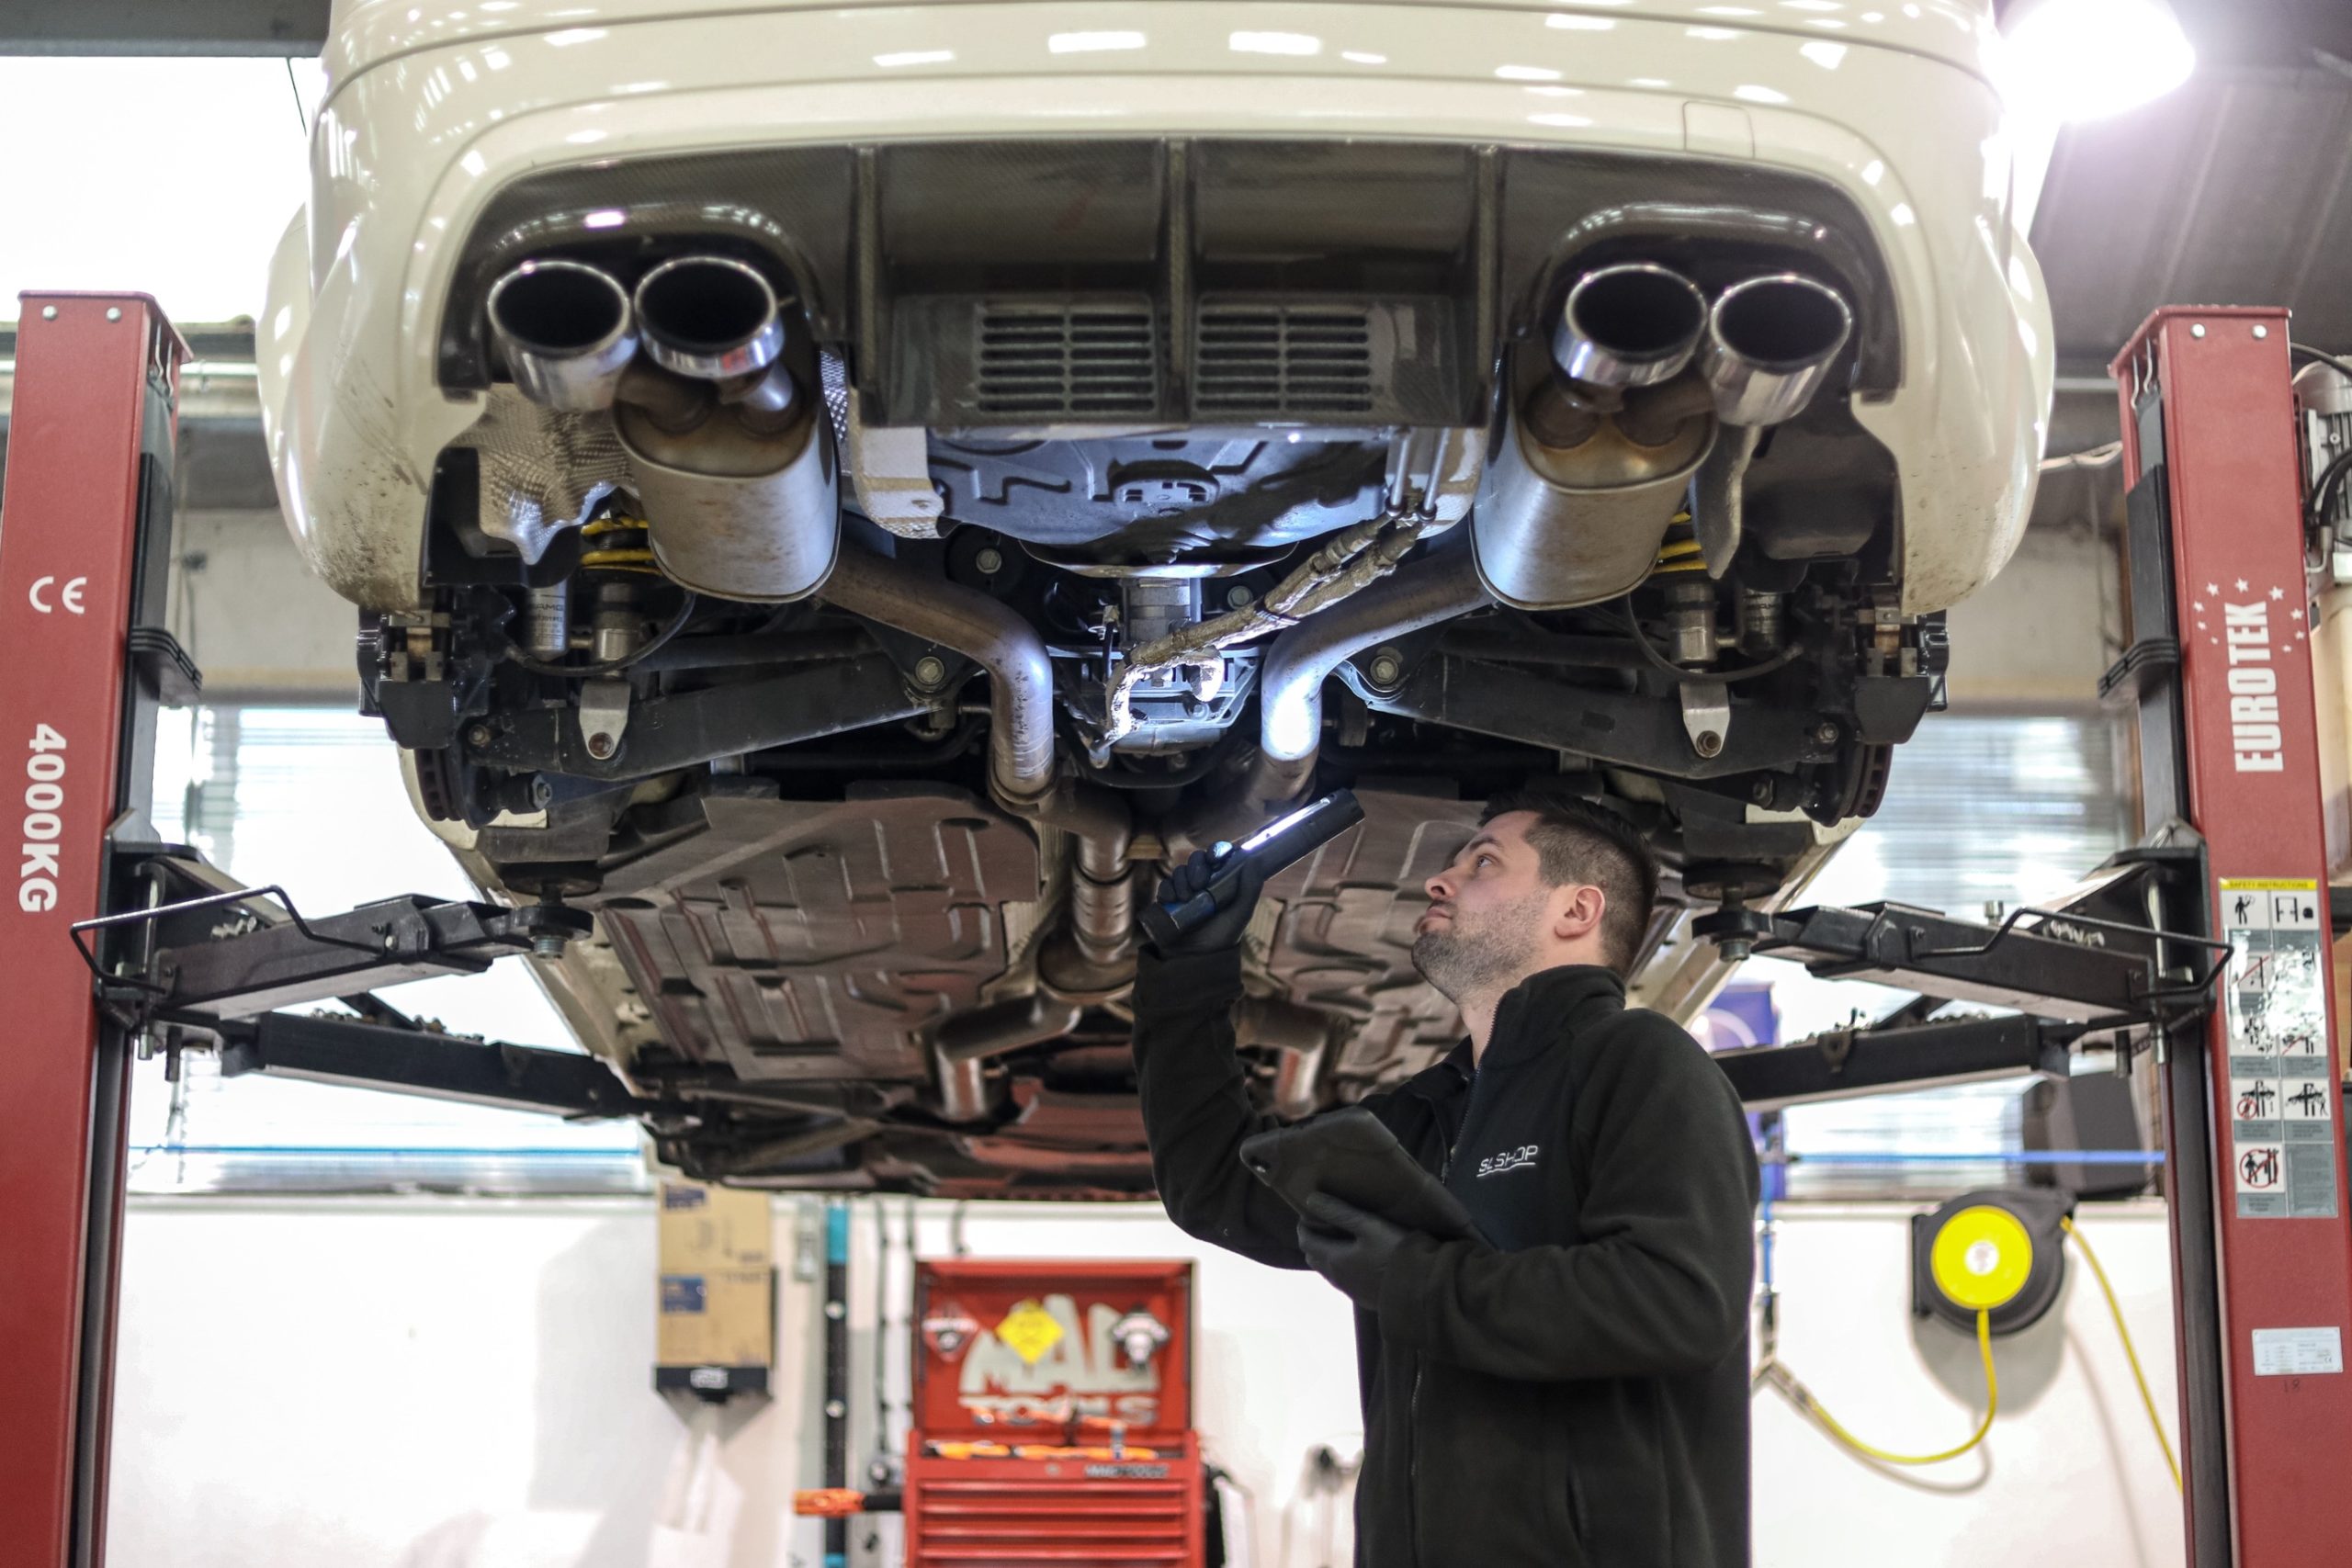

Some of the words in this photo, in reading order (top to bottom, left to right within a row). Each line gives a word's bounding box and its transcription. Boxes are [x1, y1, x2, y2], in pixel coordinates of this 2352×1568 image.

[28, 576, 87, 615] CE
[2224, 601, 2284, 772] EUROTEK
[18, 723, 68, 913] 4000KG
[1478, 1157, 1493, 1172] SL
[1494, 1145, 1538, 1168] SHOP
